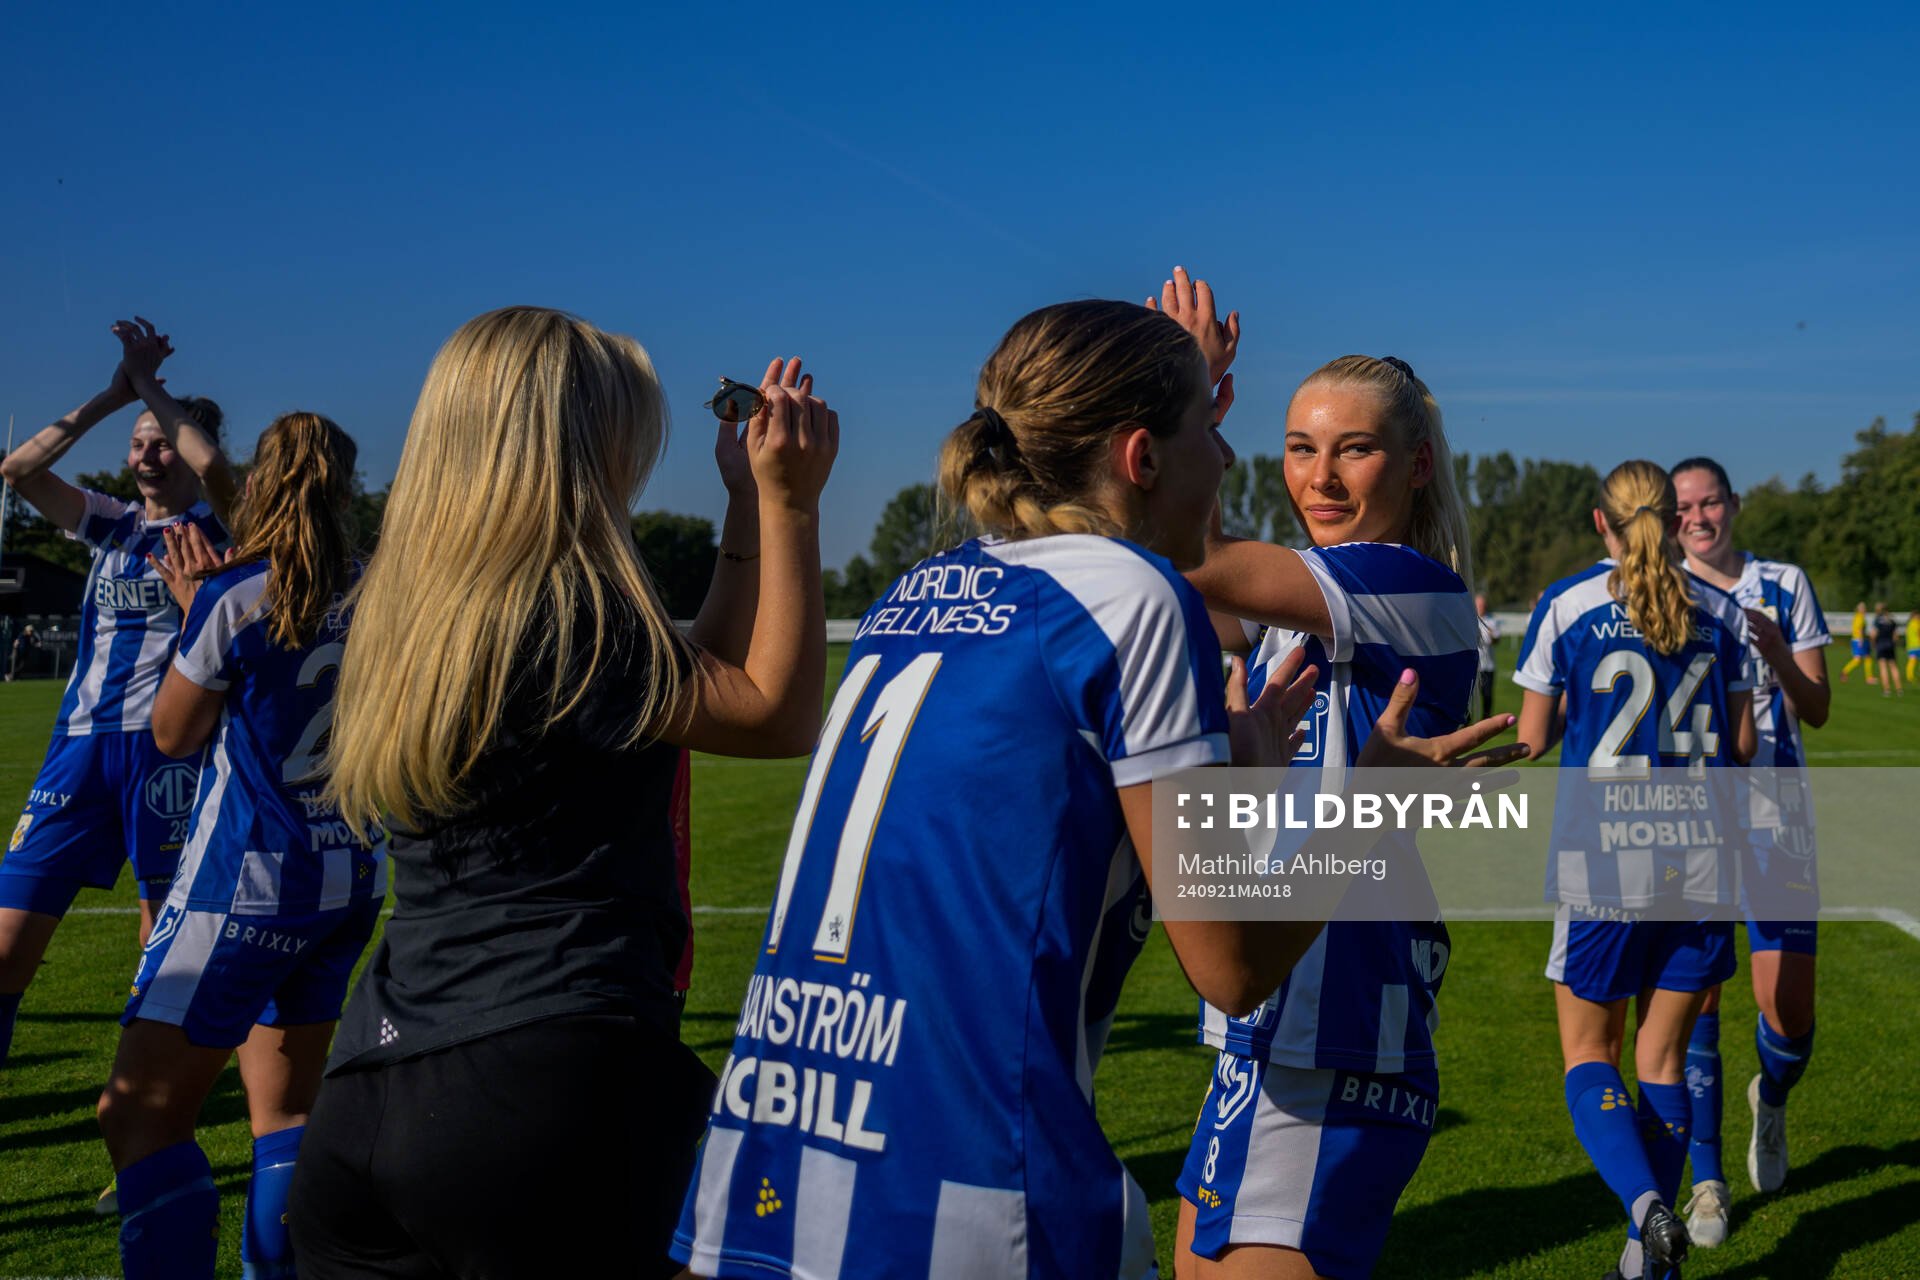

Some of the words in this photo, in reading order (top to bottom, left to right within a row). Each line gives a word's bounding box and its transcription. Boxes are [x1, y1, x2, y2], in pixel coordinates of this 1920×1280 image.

[887, 564, 1004, 603] NORDIC
[1587, 649, 1719, 782] 24
[767, 651, 943, 964] 11
[1600, 819, 1724, 852] MOBILL
[225, 921, 308, 954] BRIXLY
[1340, 1076, 1437, 1129] BRIXL
